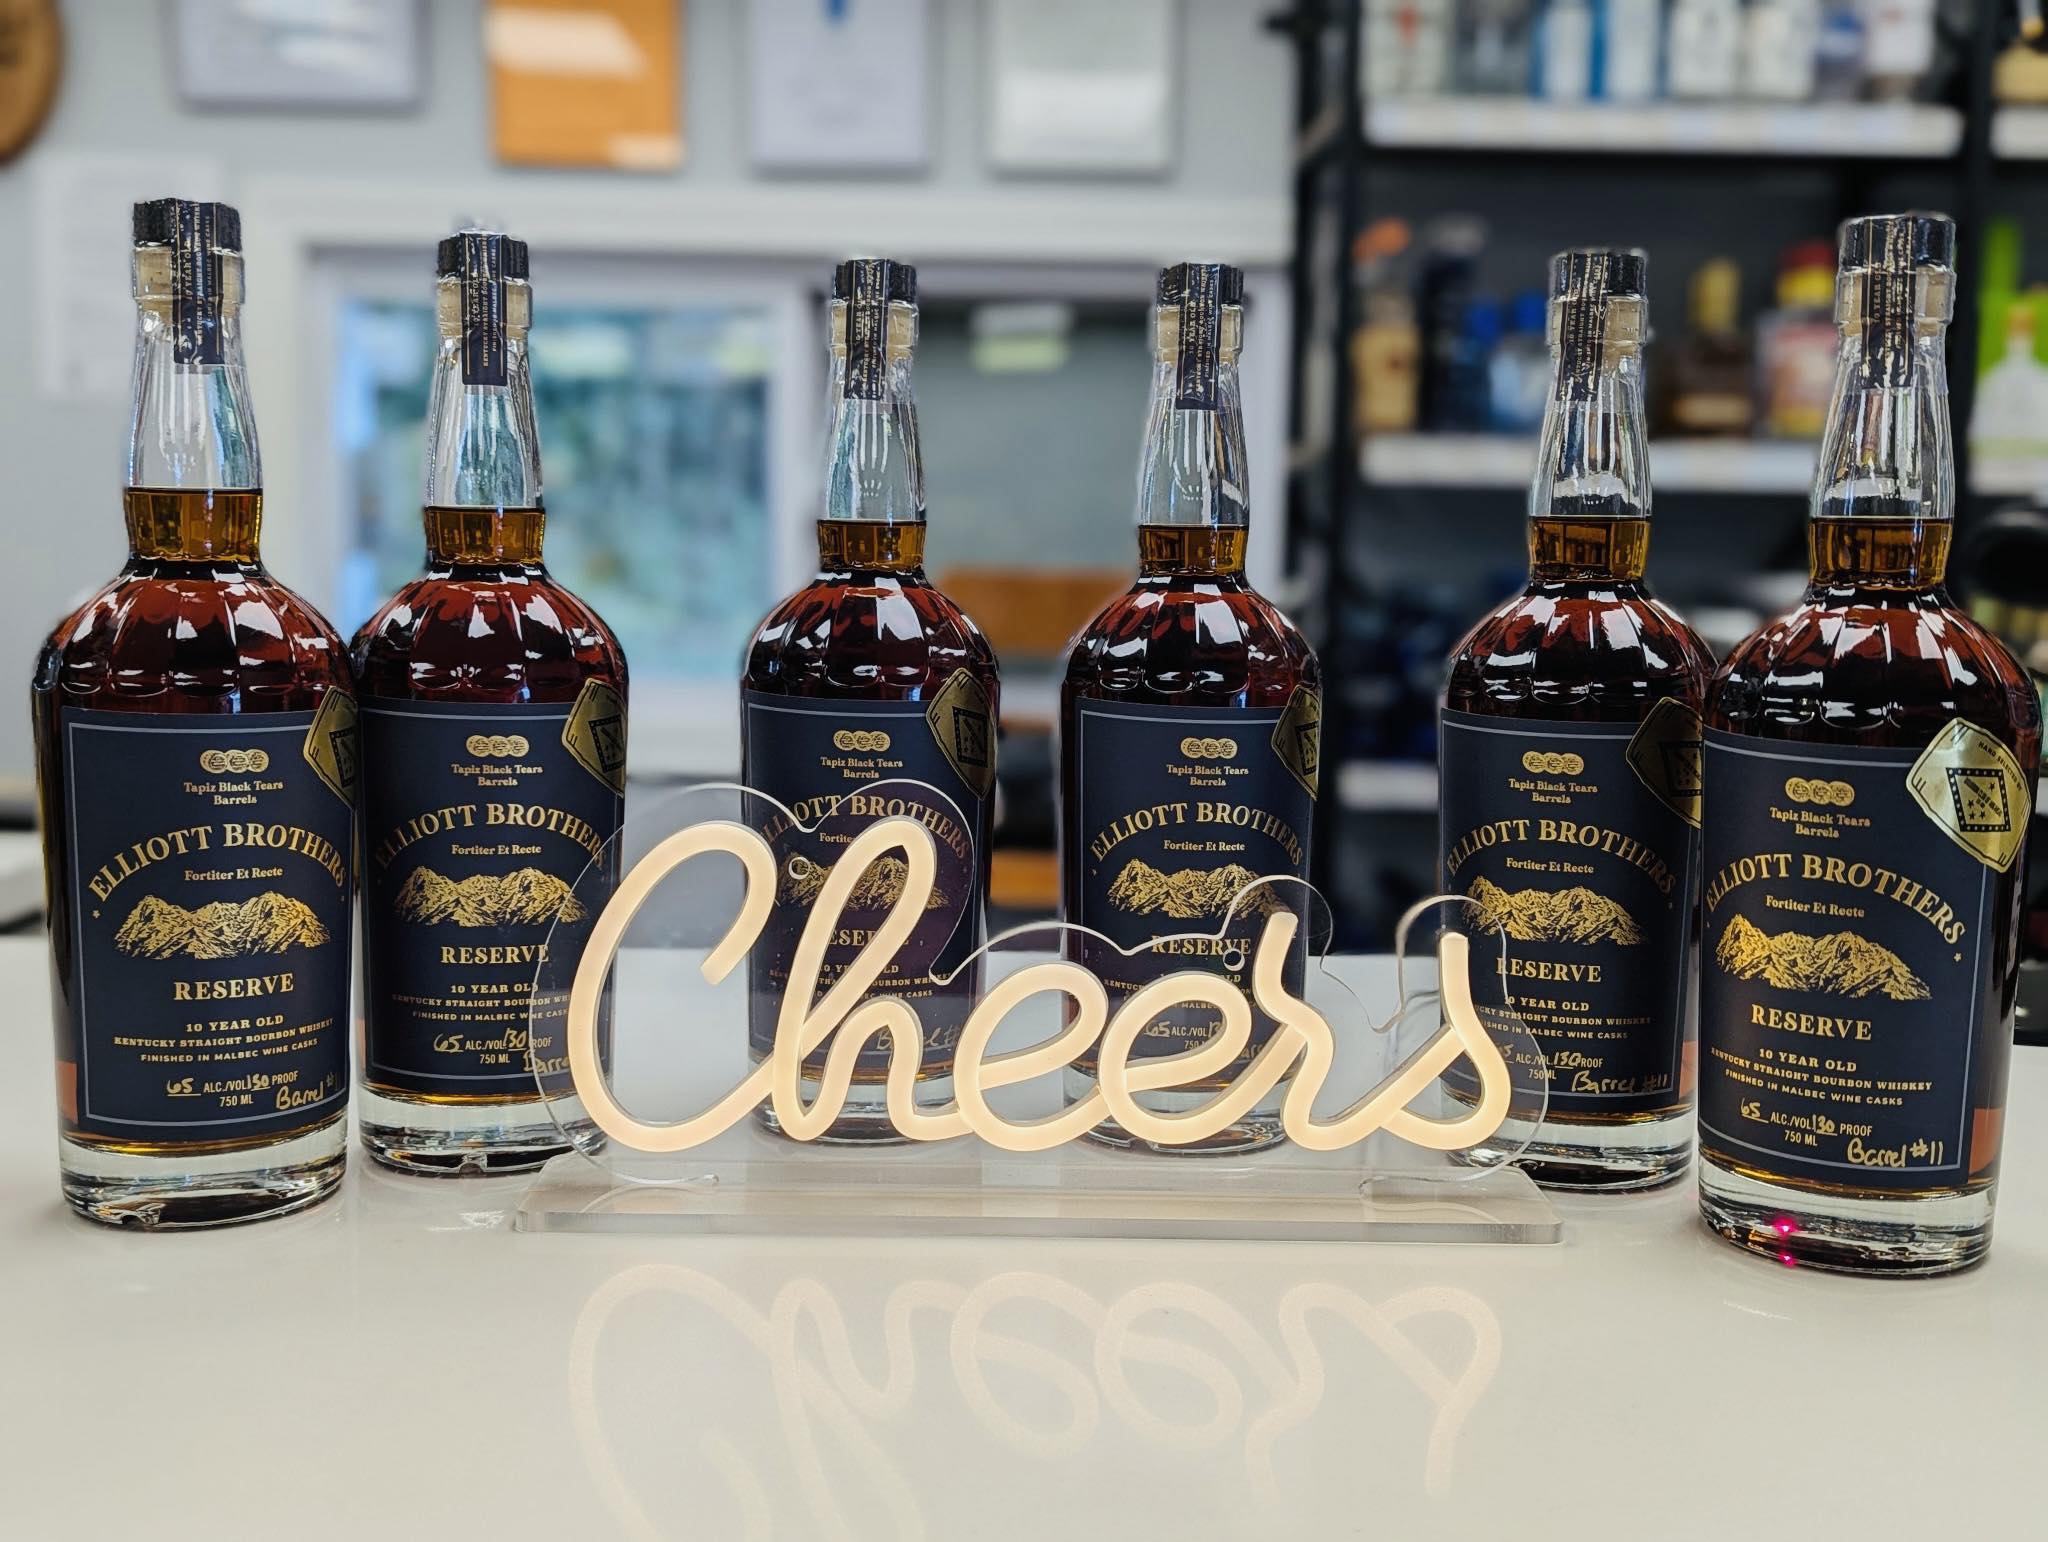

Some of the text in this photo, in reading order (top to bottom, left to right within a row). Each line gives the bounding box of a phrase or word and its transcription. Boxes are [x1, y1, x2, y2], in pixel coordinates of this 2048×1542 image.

[1568, 308, 1577, 331] YEAR
[482, 331, 490, 367] KENTUCKY
[452, 764, 543, 776] Tapiz Black Tears
[820, 756, 903, 768] Tapiz Black Tears
[1166, 764, 1249, 775] Tapiz Black Tears
[1978, 741, 1996, 757] HAND
[1997, 755, 2017, 784] SELECTED
[477, 777, 518, 787] Barrels
[843, 769, 880, 779] Barrels
[1190, 777, 1226, 786] Barrels
[184, 780, 283, 795] Tapiz Black Tears
[1508, 778, 1598, 793] Tapiz Black Tears
[214, 795, 257, 806] Barrels
[1531, 793, 1571, 804] Barrels
[1770, 807, 1871, 828] Tapiz Black Tears
[764, 794, 970, 860] LLOTT BROTHERS
[1090, 802, 1303, 865] ELLIOTT BROTHERS
[1795, 824, 1840, 839] Barrels
[376, 804, 607, 870] ELLIOTT BROTHERS
[819, 832, 855, 844] Fortite
[452, 845, 542, 856] Fortiter Et Recte
[1164, 840, 1246, 852] Fortiter Et Recte
[88, 823, 347, 902] ELLIOTT BROTHERS
[1447, 819, 1676, 894] ELLIOTT BROTHERS
[184, 867, 284, 881] Fortiter Et Recte
[1506, 857, 1594, 874] Fortiter Et Recte
[1706, 853, 1966, 944] ELLIOTT BROTHERS
[1766, 895, 1865, 918] Fortiter Et Recte
[1151, 935, 1251, 955] RESERVE
[441, 944, 550, 964] RESERVE
[1496, 957, 1601, 983] RESERVE
[174, 972, 294, 1000] RESERVE
[450, 985, 466, 994] 10
[471, 984, 509, 994] YEAR
[567, 817, 1510, 1153] Cheers
[871, 977, 911, 987] OURBON
[1103, 979, 1146, 992] KENTUC
[906, 990, 932, 998] CASKS
[445, 999, 500, 1008] STRAIGHT
[1520, 997, 1556, 1009] YEAR
[1562, 1002, 1590, 1011] OLD
[186, 1015, 284, 1032] 10 YEAR OLD
[460, 1013, 471, 1021] IN
[475, 1013, 516, 1021] MALBEC
[519, 1011, 543, 1020] WNE
[1499, 1010, 1548, 1022] STRAIGHT
[1552, 1016, 1603, 1026] BOURBON
[1751, 1004, 1873, 1041] RESERVE
[114, 1018, 334, 1048] KENTUCKY STRAIGHT BOURBON WHISKEY
[1482, 1020, 1509, 1032] ISHED
[1512, 1026, 1522, 1034] IN
[1567, 1031, 1594, 1039] WINE
[433, 1033, 464, 1051] 65
[503, 1028, 527, 1048] 130
[140, 1054, 193, 1062] FINISHED
[214, 1050, 258, 1061] MALBEC
[262, 1046, 288, 1056] WINE
[292, 1038, 318, 1050] CASKS
[479, 1054, 510, 1064] 750 ML
[1759, 1048, 1857, 1072] 10 YEAR OLD
[1528, 1068, 1544, 1080] 750
[1711, 1047, 1932, 1091] KENTUCKY STRAIGHT BOURBON WHISKEY
[167, 1077, 194, 1093] 65
[271, 1071, 299, 1086] PROOF
[1725, 1068, 1903, 1106] FINISHED IN MALBEC WINE CASKS
[219, 1095, 254, 1108] 750 ML
[1740, 1097, 1761, 1117] 65
[1812, 1113, 1836, 1134] 130
[1839, 1122, 1873, 1137] PROOF
[1784, 1130, 1818, 1147] 750 ML
[1847, 1137, 1944, 1167] Barrel #11
